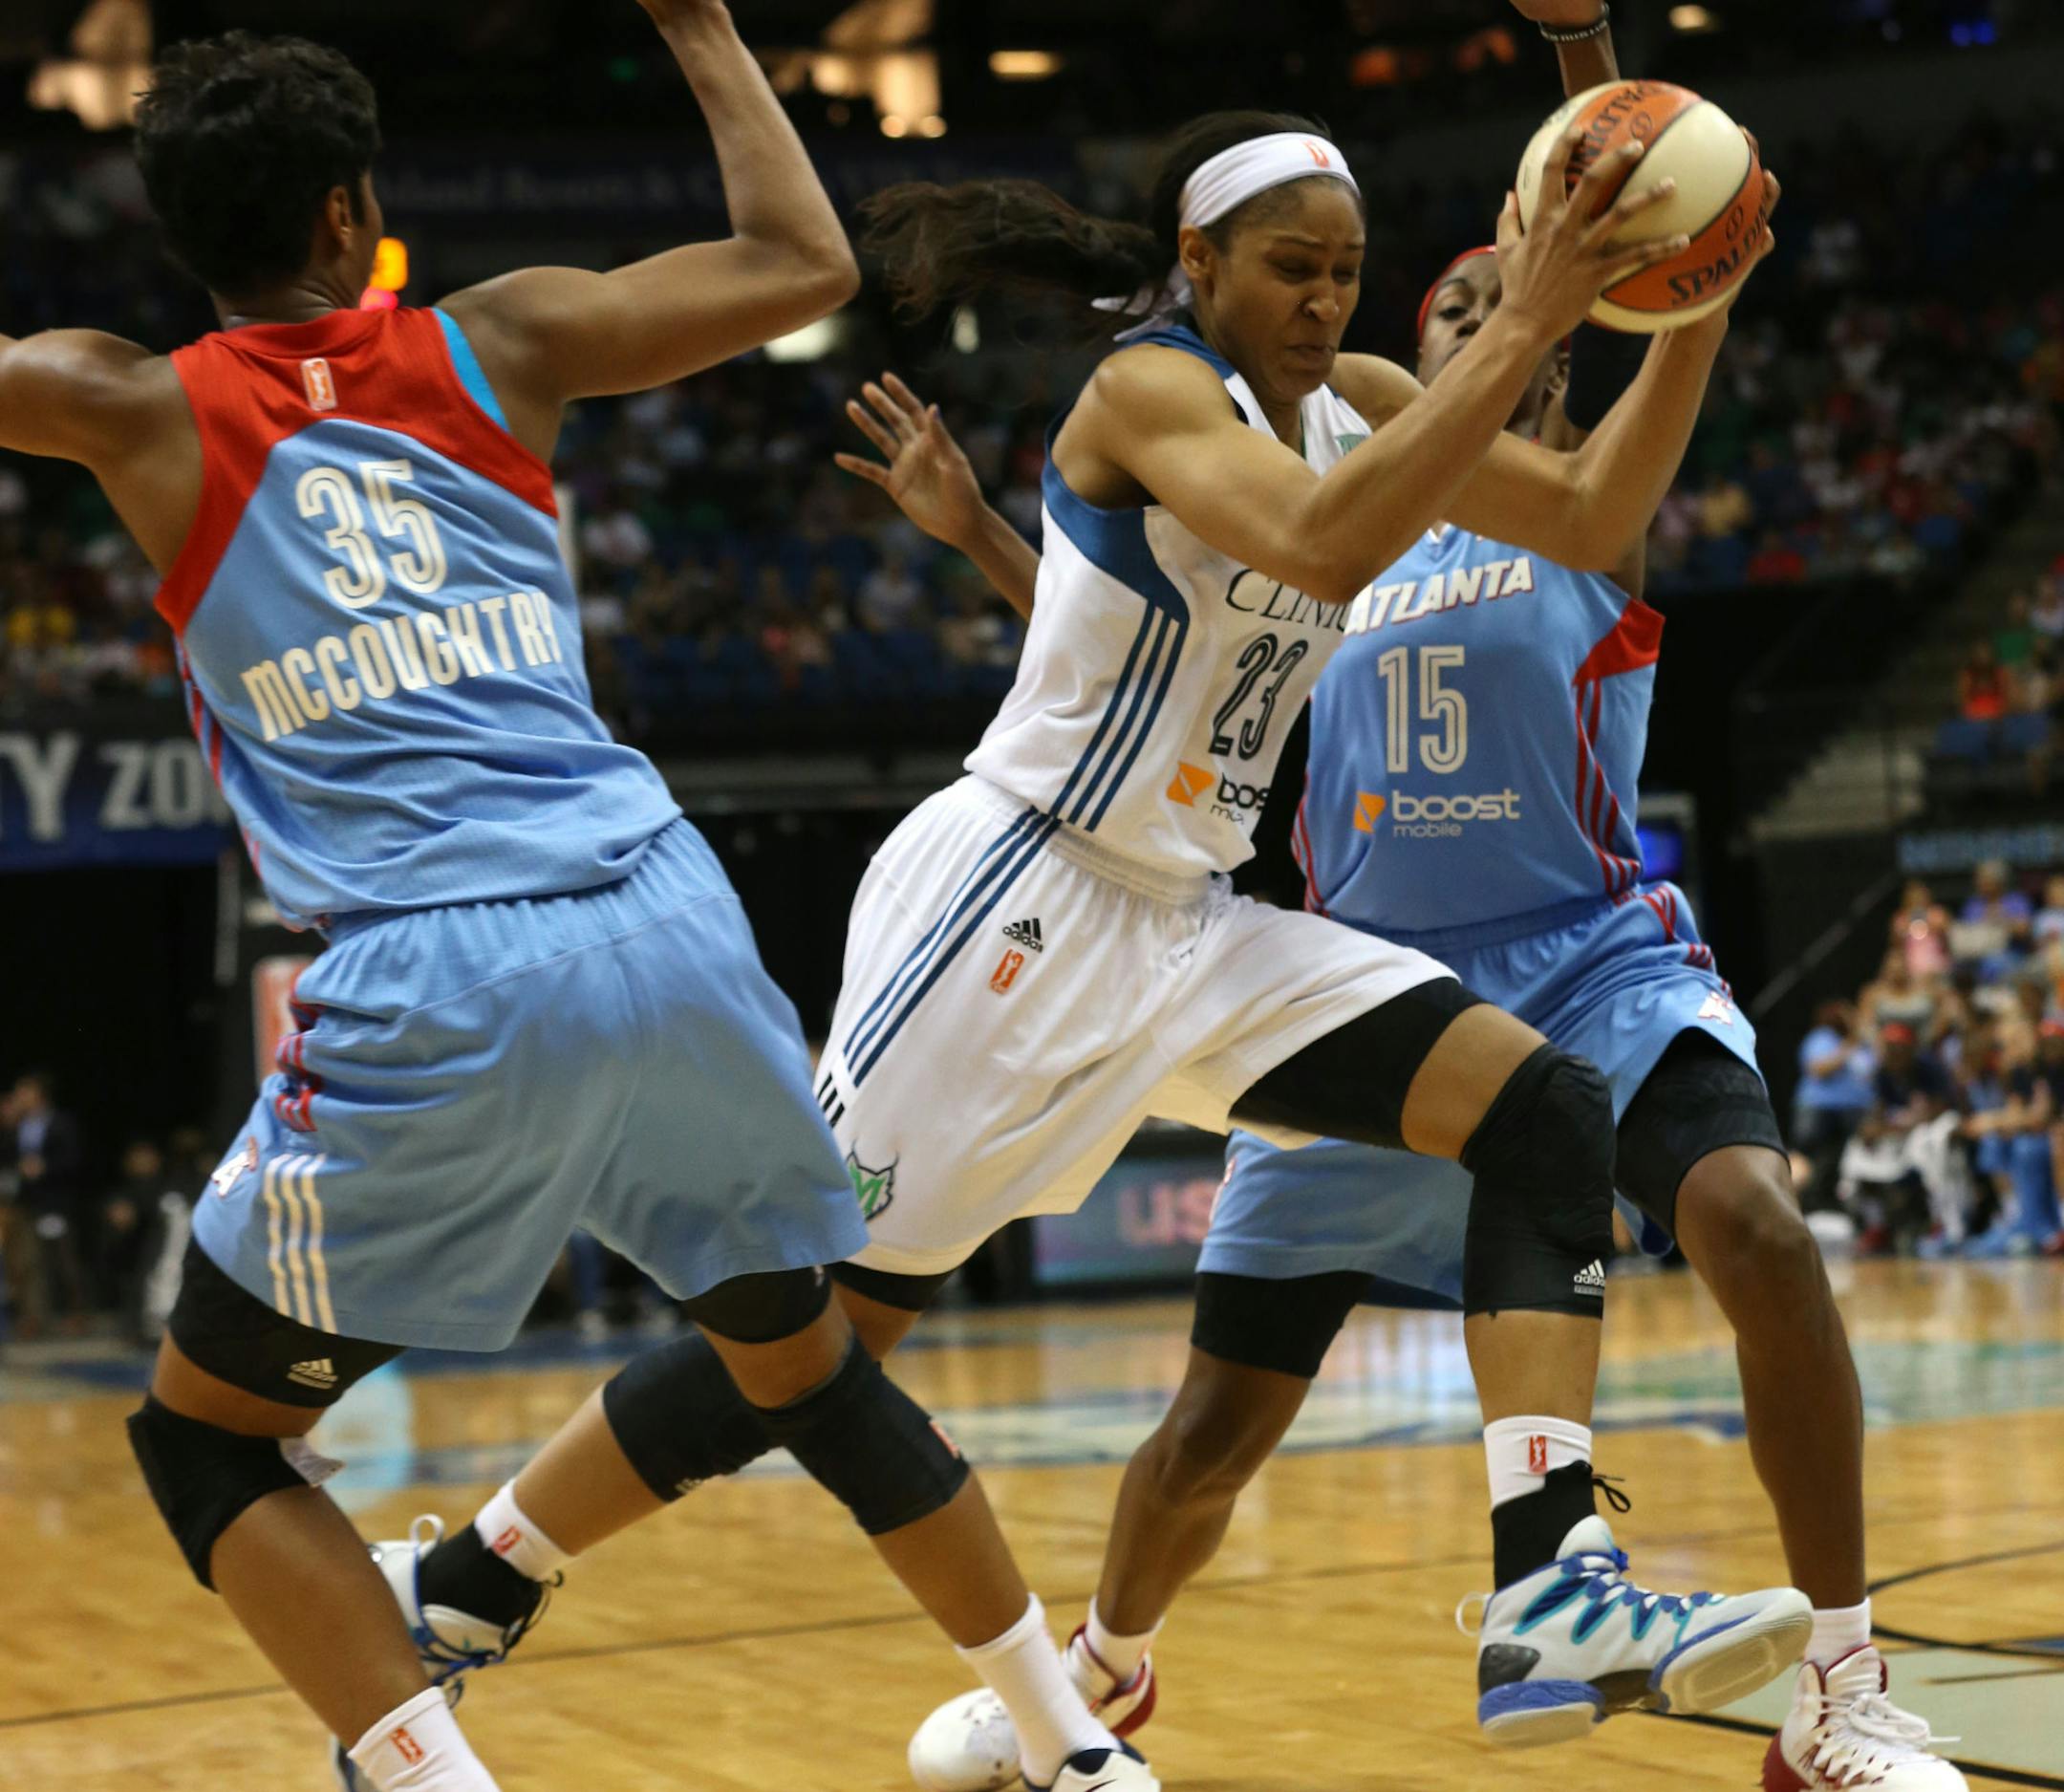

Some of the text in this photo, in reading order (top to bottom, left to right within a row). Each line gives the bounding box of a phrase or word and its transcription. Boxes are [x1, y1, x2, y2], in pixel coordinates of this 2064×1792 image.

[295, 459, 447, 610] 35
[1344, 557, 1533, 637] ATLANTA
[1209, 633, 1309, 761] 23
[1378, 645, 1468, 774] 15
[97, 739, 231, 830] ZO
[1392, 788, 1520, 821] boost
[1393, 824, 1462, 837] mobile
[1002, 926, 1043, 953] adidas
[1574, 1273, 1605, 1286] adida
